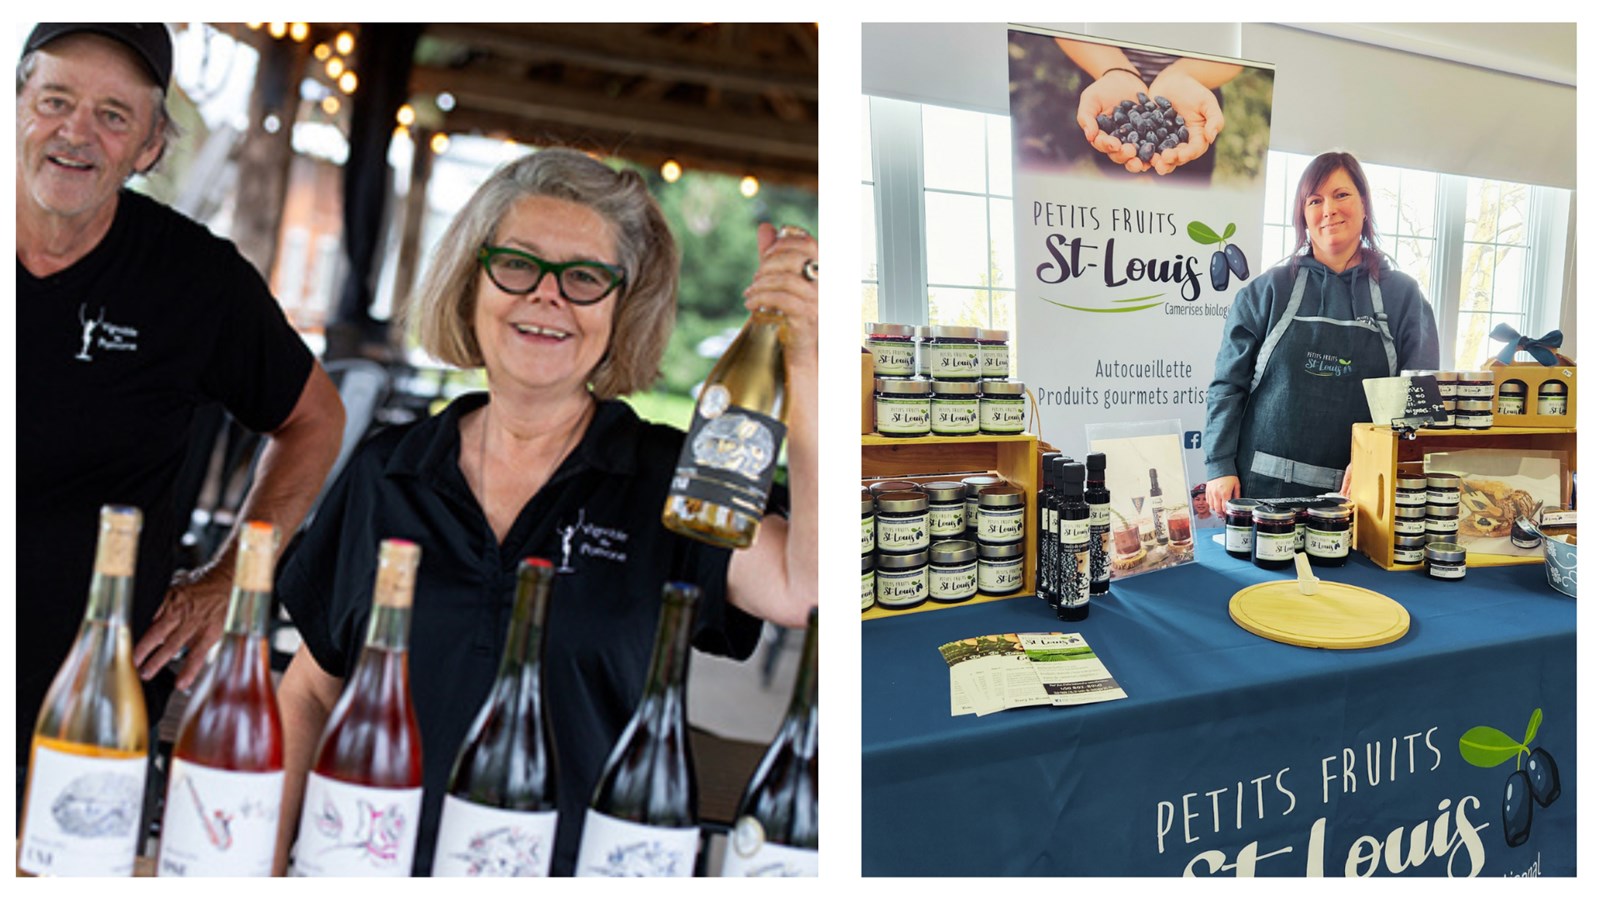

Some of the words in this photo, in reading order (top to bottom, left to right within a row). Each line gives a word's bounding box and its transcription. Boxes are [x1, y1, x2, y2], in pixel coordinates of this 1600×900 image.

[1033, 201, 1100, 231] PETITS
[1112, 207, 1177, 236] FRUITS
[1036, 233, 1203, 302] St-Louis
[1165, 302, 1204, 316] Camerises
[1095, 359, 1193, 378] Autocueillette
[1038, 386, 1099, 406] Produits
[1104, 388, 1169, 409] gourmets
[1157, 767, 1296, 854] PETITS
[1321, 726, 1442, 804] FRUITS
